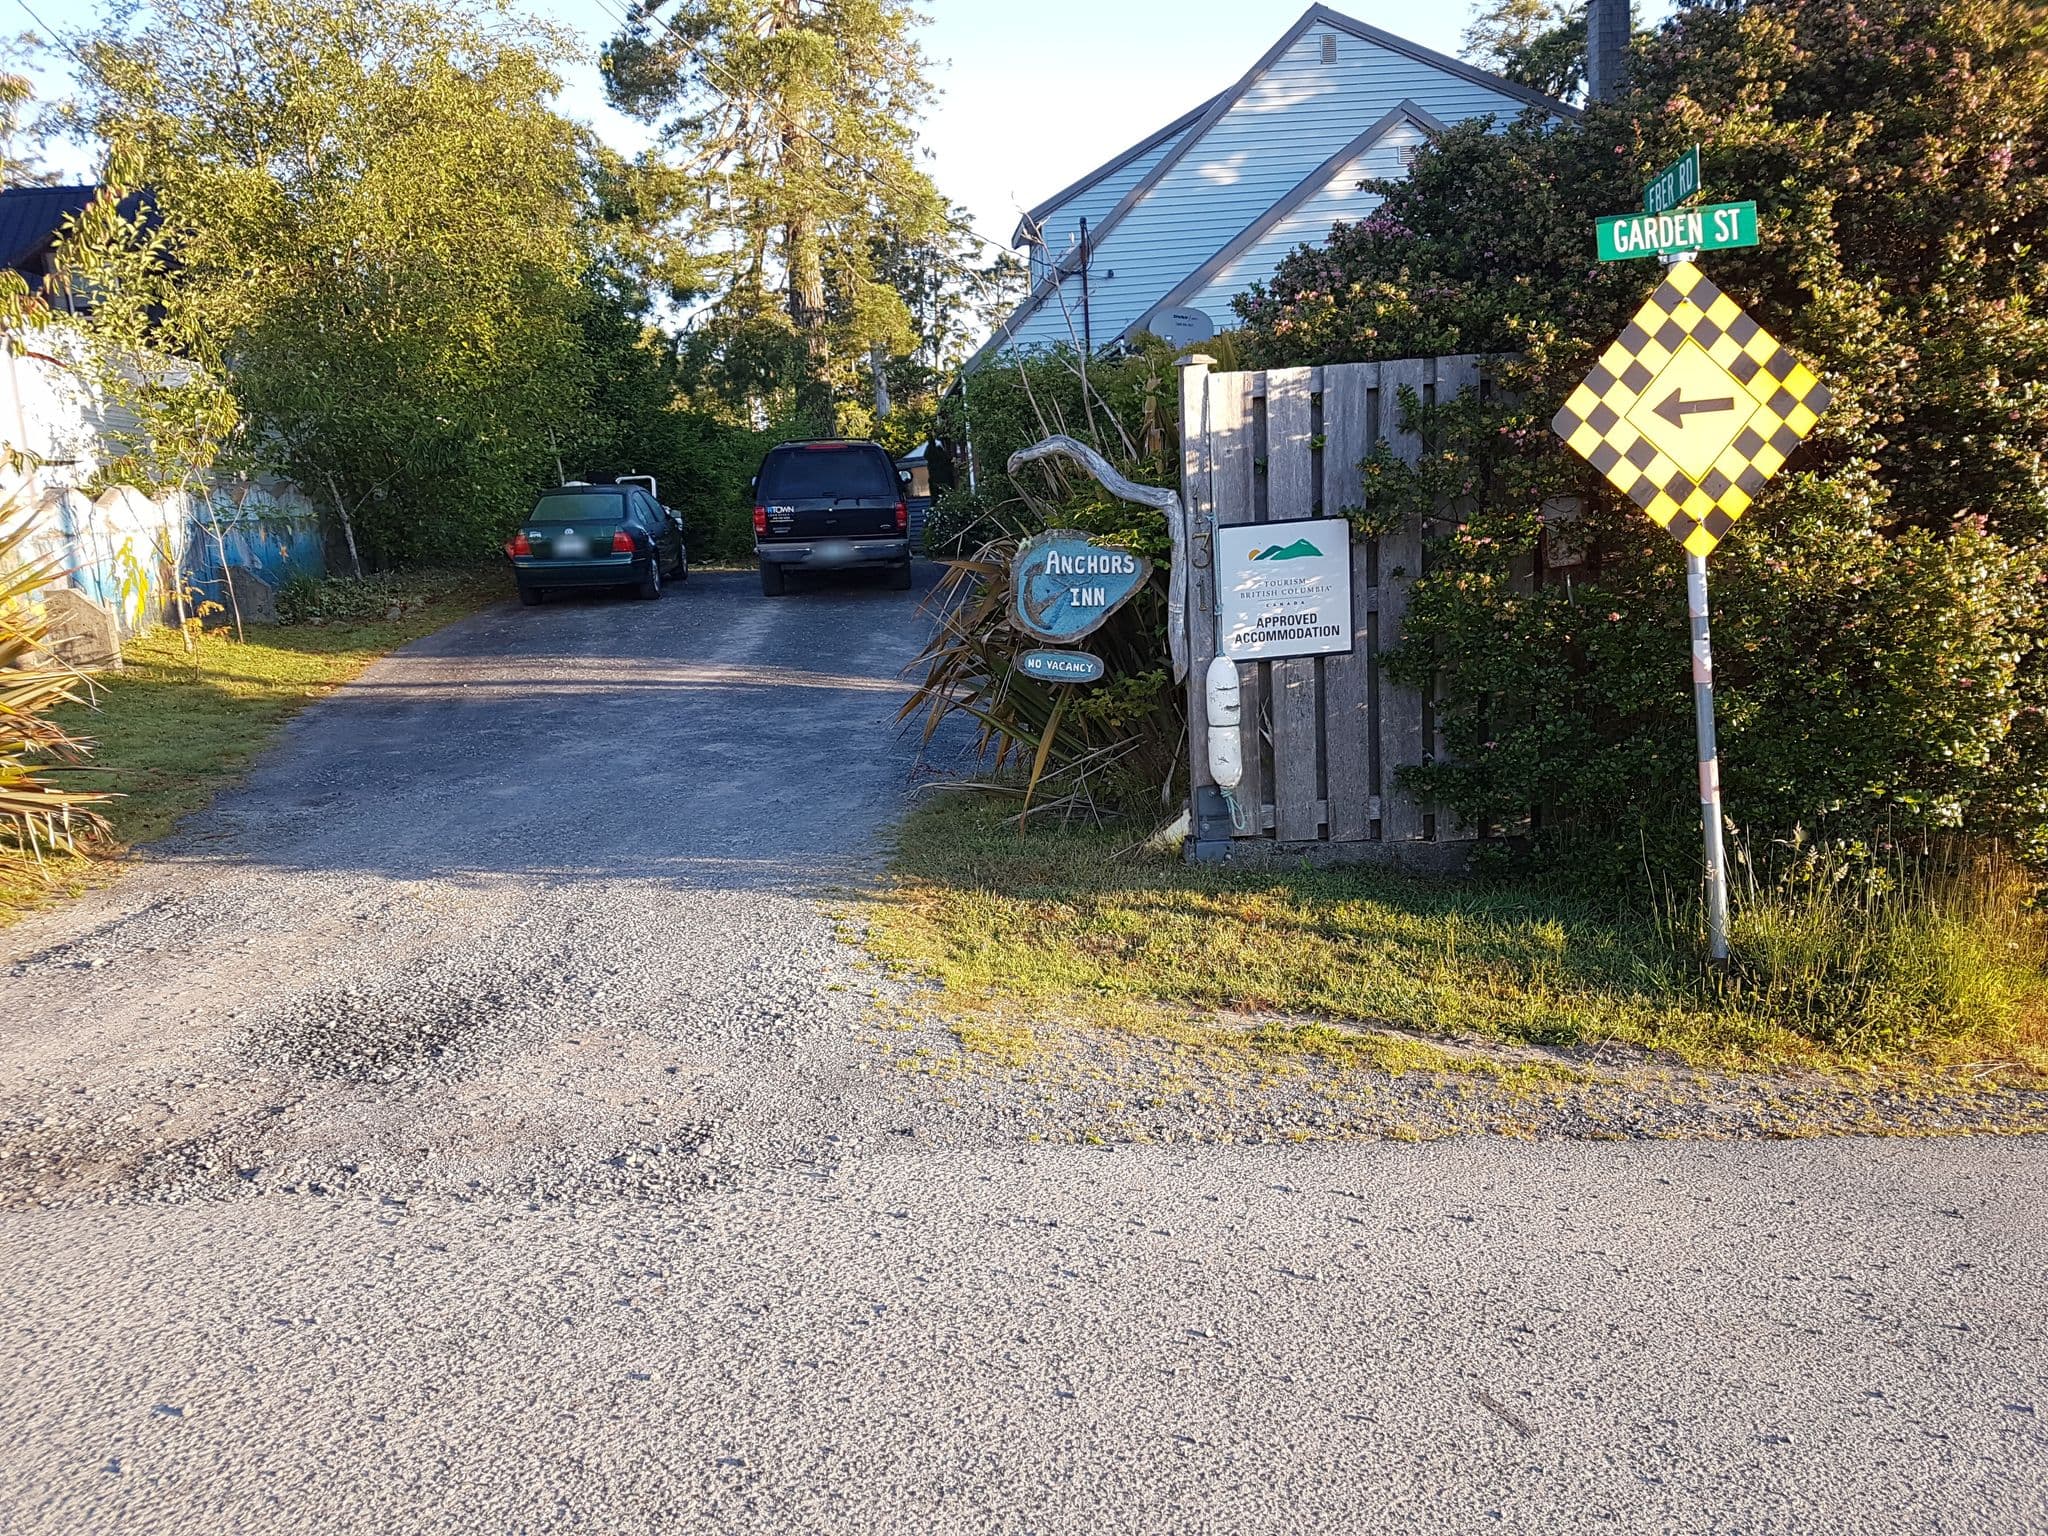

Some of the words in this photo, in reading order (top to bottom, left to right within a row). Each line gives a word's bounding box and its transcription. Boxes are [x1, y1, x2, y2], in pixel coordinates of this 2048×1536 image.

[1679, 157, 1693, 196] RD
[1613, 213, 1703, 253] GARDEN
[1715, 208, 1740, 242] ST
[1045, 551, 1135, 575] ANCHORS
[1264, 578, 1306, 588] TOURISM
[1070, 588, 1105, 607] INN
[1240, 588, 1277, 599] BRITISH
[1256, 612, 1318, 629] APPROVED
[1234, 624, 1340, 644] ACCOMMODATION
[1028, 659, 1042, 669] NO
[1047, 659, 1094, 673] VACANCY
